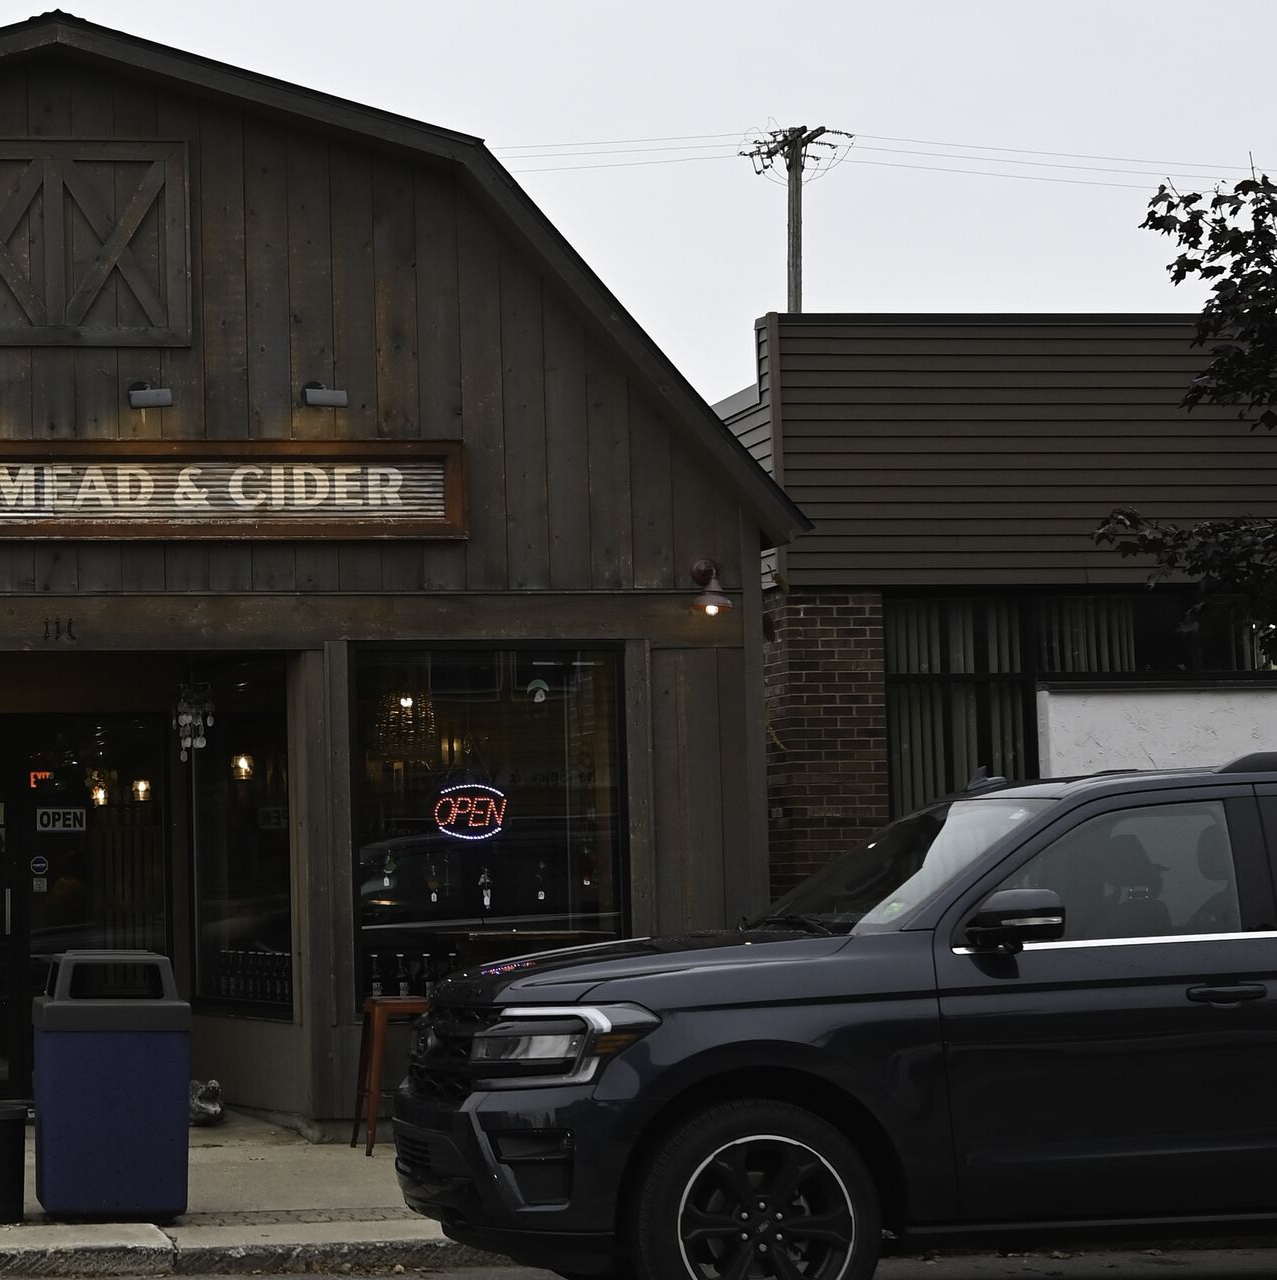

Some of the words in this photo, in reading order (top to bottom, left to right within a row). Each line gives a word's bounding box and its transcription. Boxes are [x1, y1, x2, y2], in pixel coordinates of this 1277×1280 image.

[173, 464, 212, 509] &
[227, 464, 405, 510] CIDER
[39, 810, 84, 828] OPEN
[434, 797, 507, 827] OPEN
